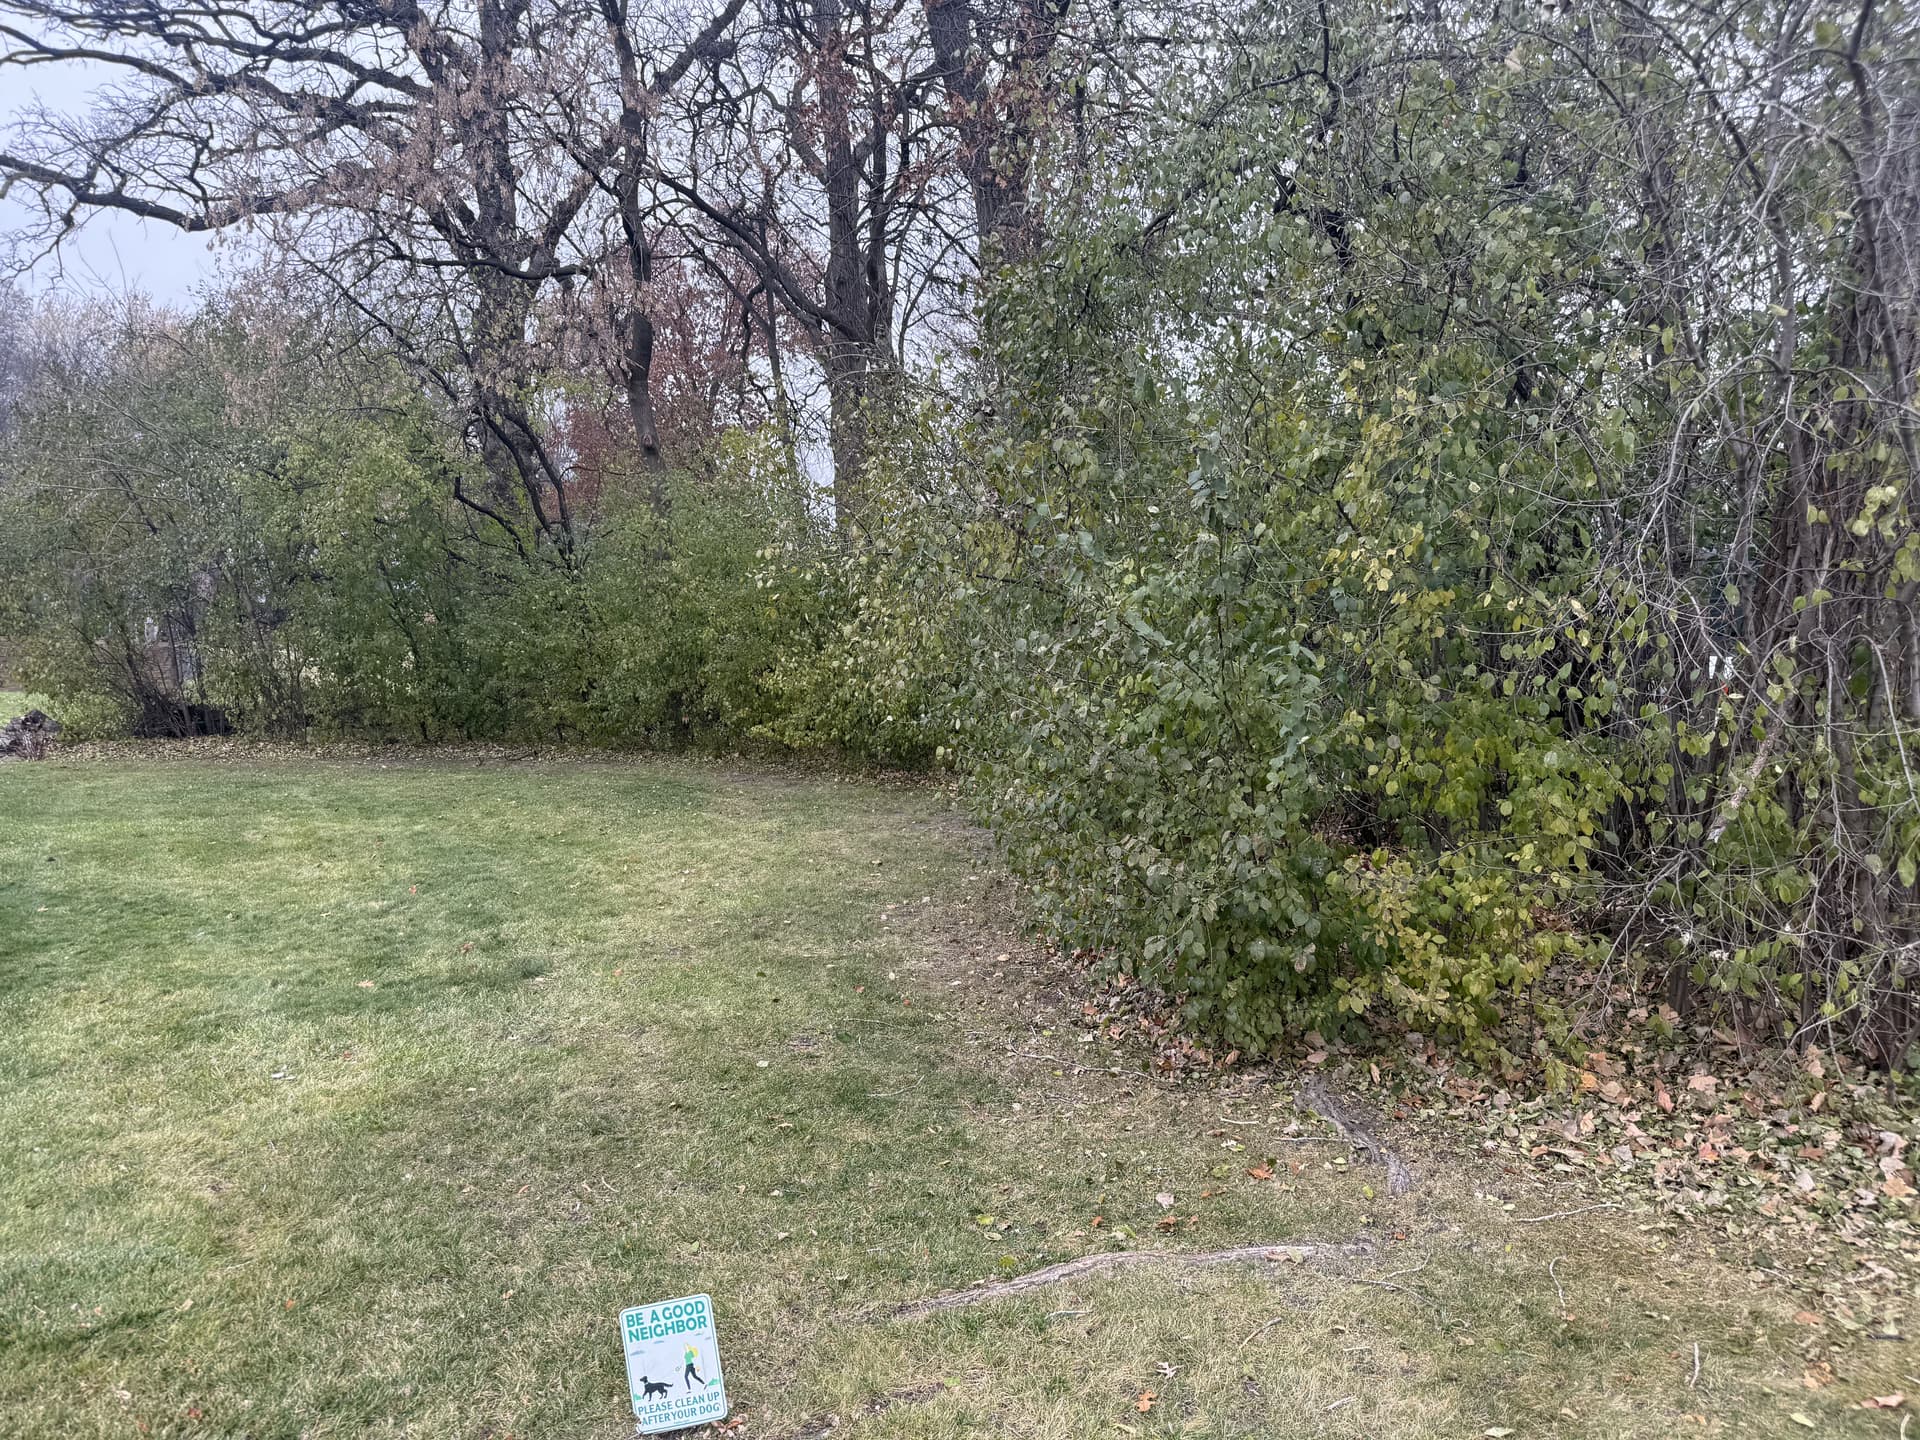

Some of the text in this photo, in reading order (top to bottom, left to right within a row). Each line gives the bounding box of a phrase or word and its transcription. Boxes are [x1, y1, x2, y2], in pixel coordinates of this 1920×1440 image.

[625, 1300, 705, 1328] BE A GOOD
[628, 1315, 708, 1343] NEIGHBOR
[638, 1391, 720, 1415] PLEASE CLEAN UP
[641, 1402, 720, 1426] AFTER YOUR DOG
